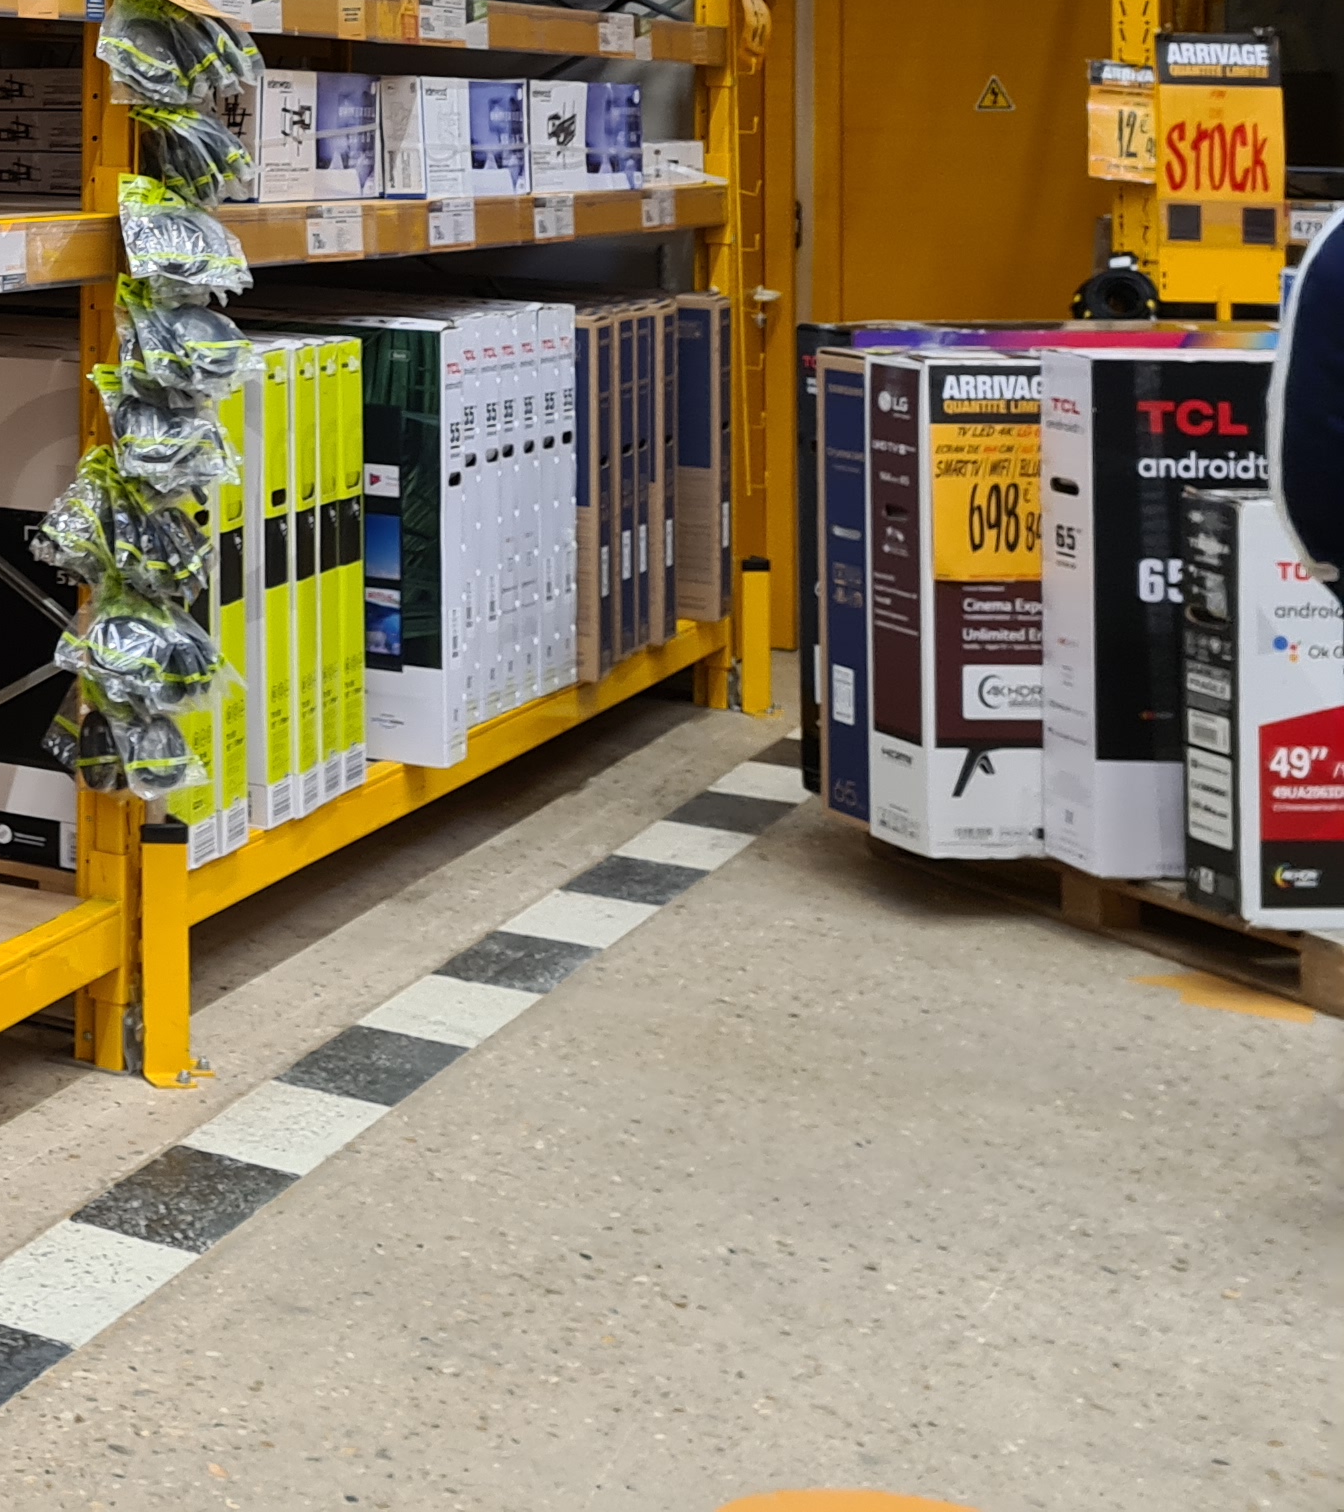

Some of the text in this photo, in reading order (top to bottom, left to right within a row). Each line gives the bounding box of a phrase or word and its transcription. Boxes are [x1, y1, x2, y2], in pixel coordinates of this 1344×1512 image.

[1167, 42, 1269, 66] ARRIVAGE
[1117, 109, 1137, 159] 12
[892, 397, 908, 412] LG
[1052, 398, 1080, 414] TCL
[1137, 399, 1248, 435] TCL
[1138, 451, 1269, 479] androidt
[969, 483, 1020, 553] 698
[963, 598, 1012, 612] Cinema
[963, 627, 1022, 641] Unlimited
[1269, 746, 1328, 779] 49"
